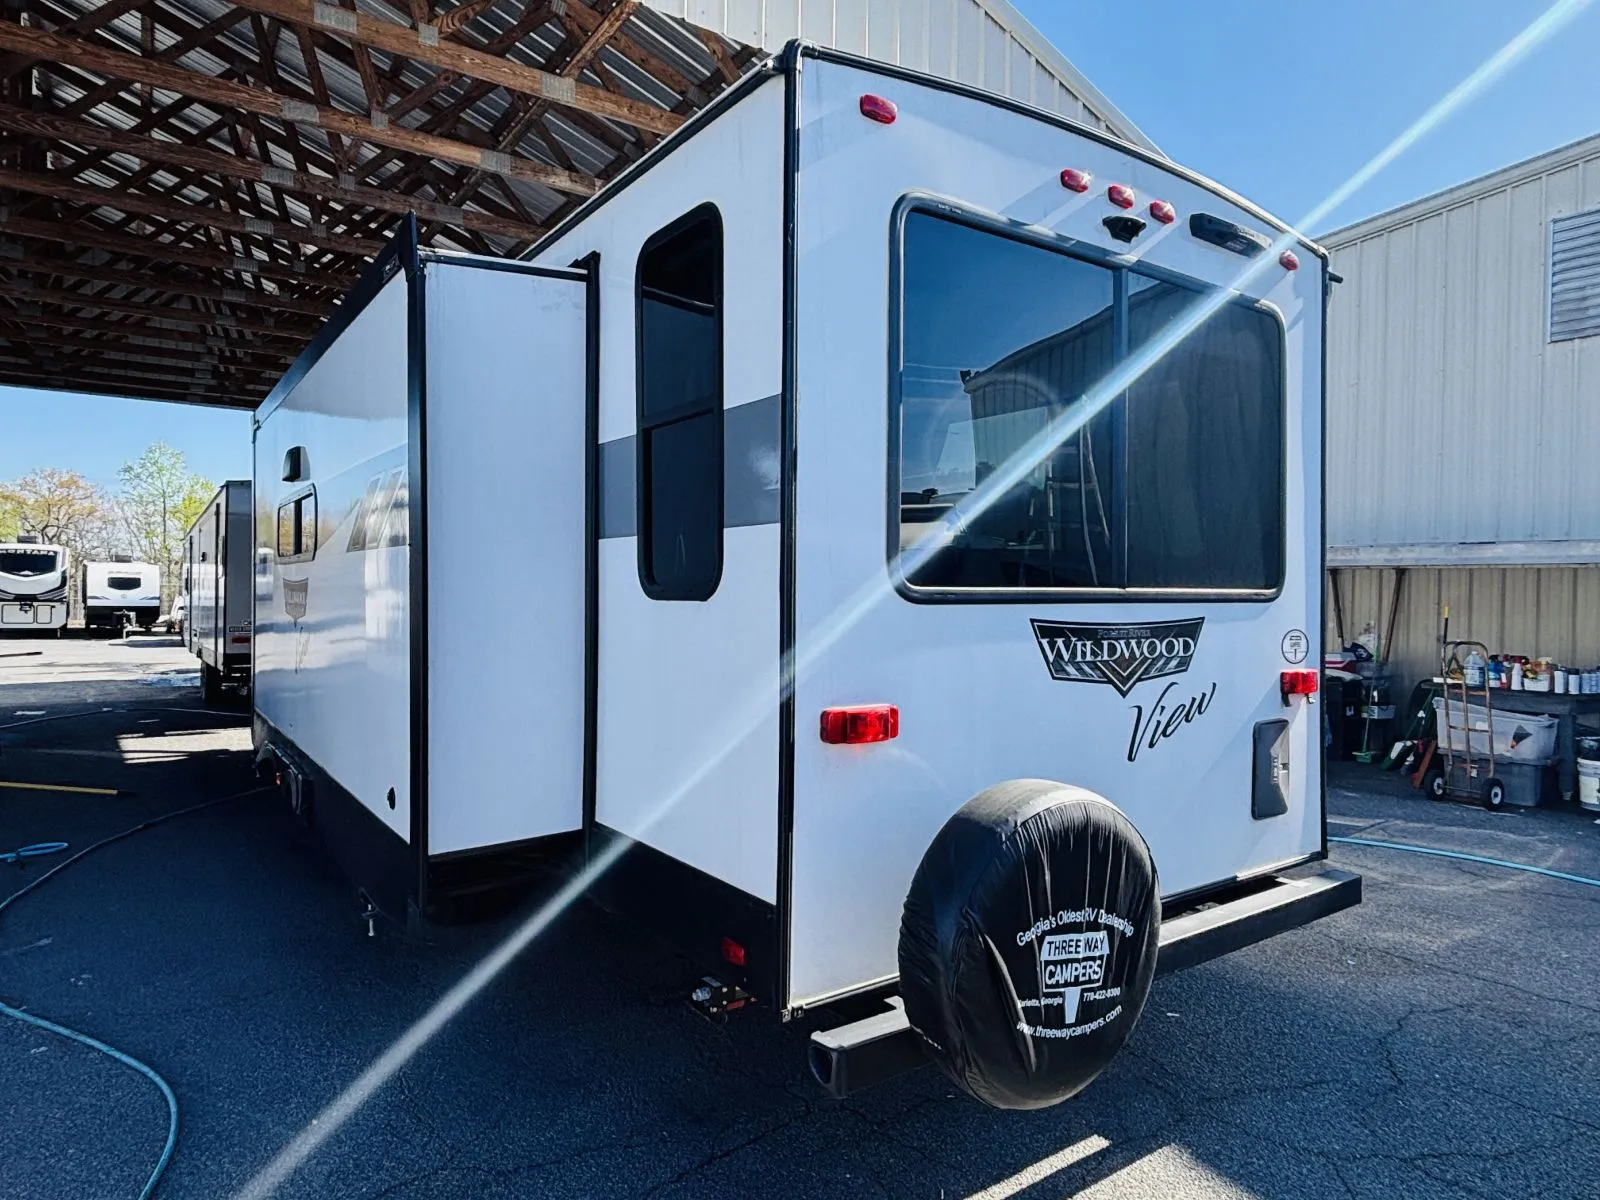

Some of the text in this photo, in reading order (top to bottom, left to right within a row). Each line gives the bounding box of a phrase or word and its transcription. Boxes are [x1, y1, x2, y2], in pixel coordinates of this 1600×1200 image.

[1038, 636, 1195, 663] WILDWOOD
[1127, 682, 1217, 762] View
[1016, 908, 1135, 946] Georgia's Oldest RV Dealership
[1047, 935, 1106, 957] THREE WAY
[1045, 960, 1102, 985] CAMPERS
[1016, 1004, 1123, 1040] www.threewaycampers.com
